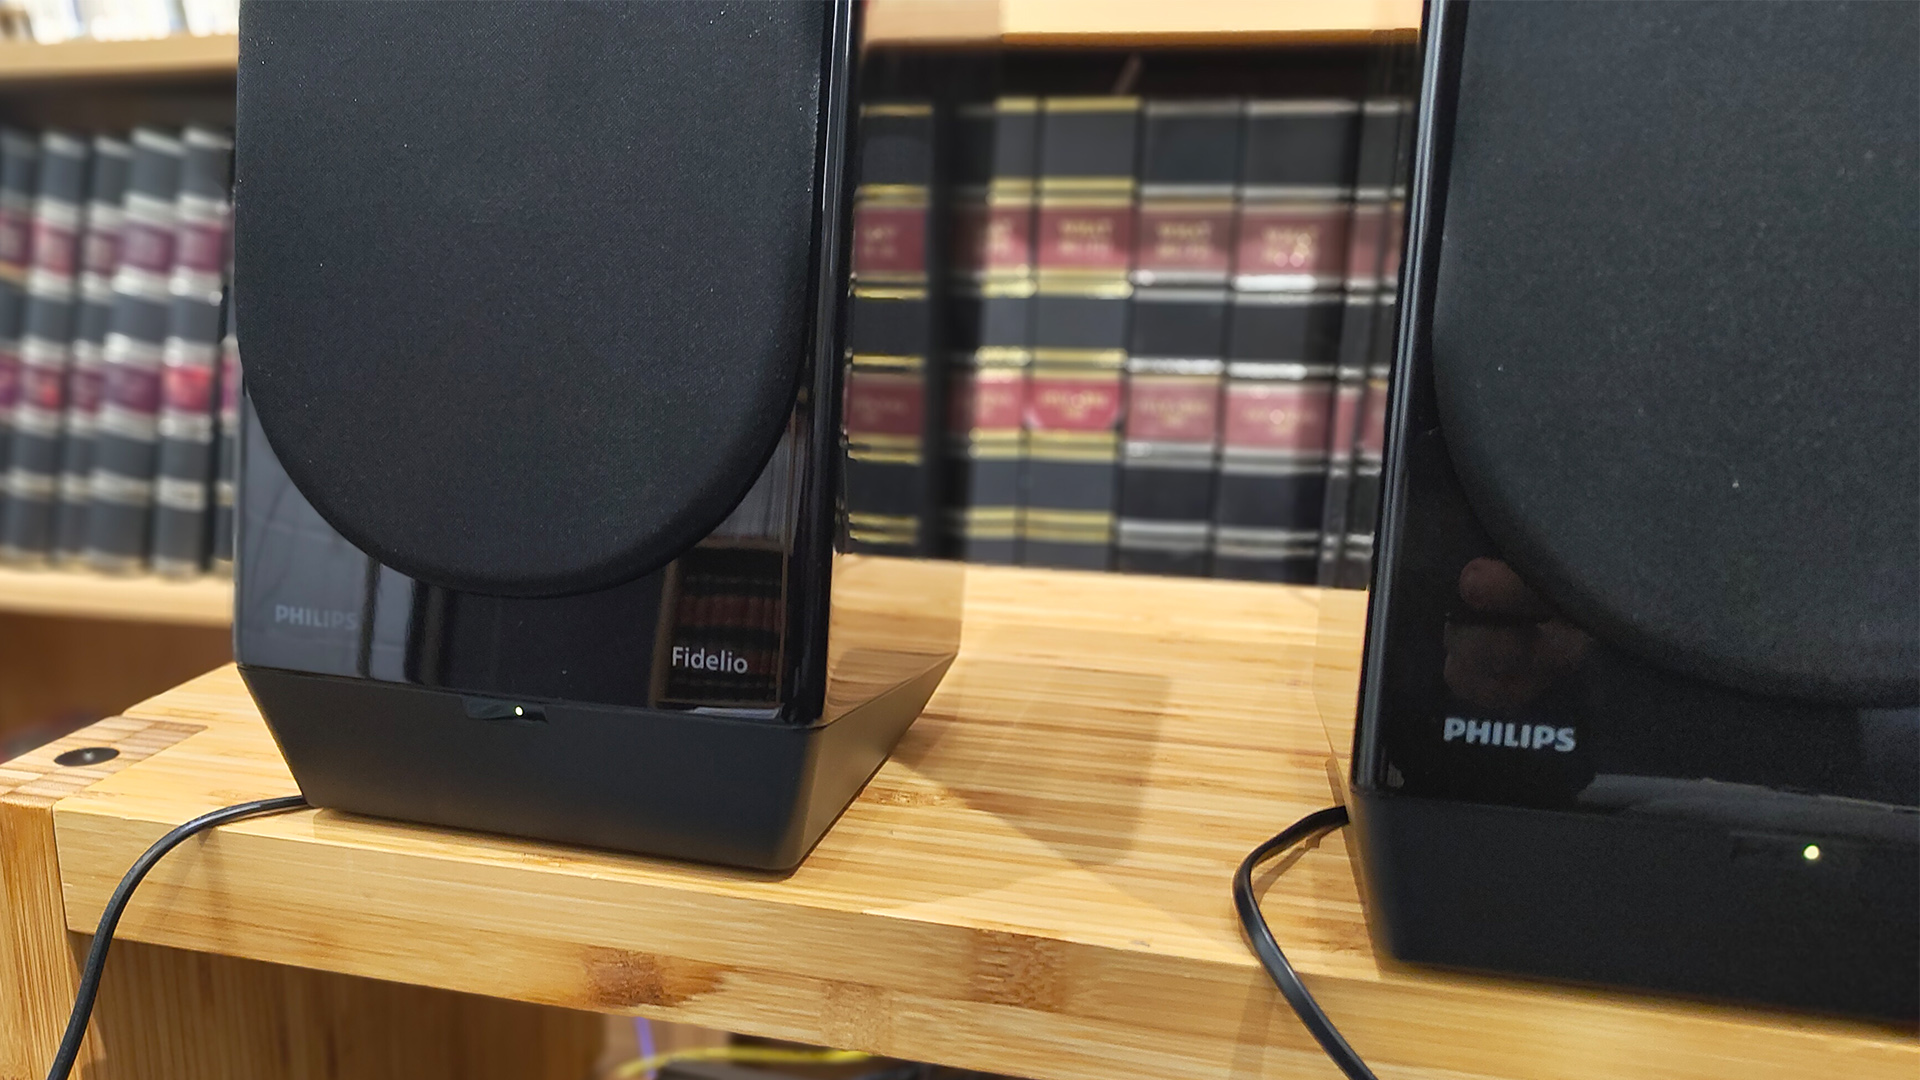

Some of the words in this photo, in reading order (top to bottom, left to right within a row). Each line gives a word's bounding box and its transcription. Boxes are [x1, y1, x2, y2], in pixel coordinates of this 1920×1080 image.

[275, 604, 358, 630] PHILIPS
[672, 646, 748, 674] Fidelio
[1443, 717, 1576, 752] PHILIPS
